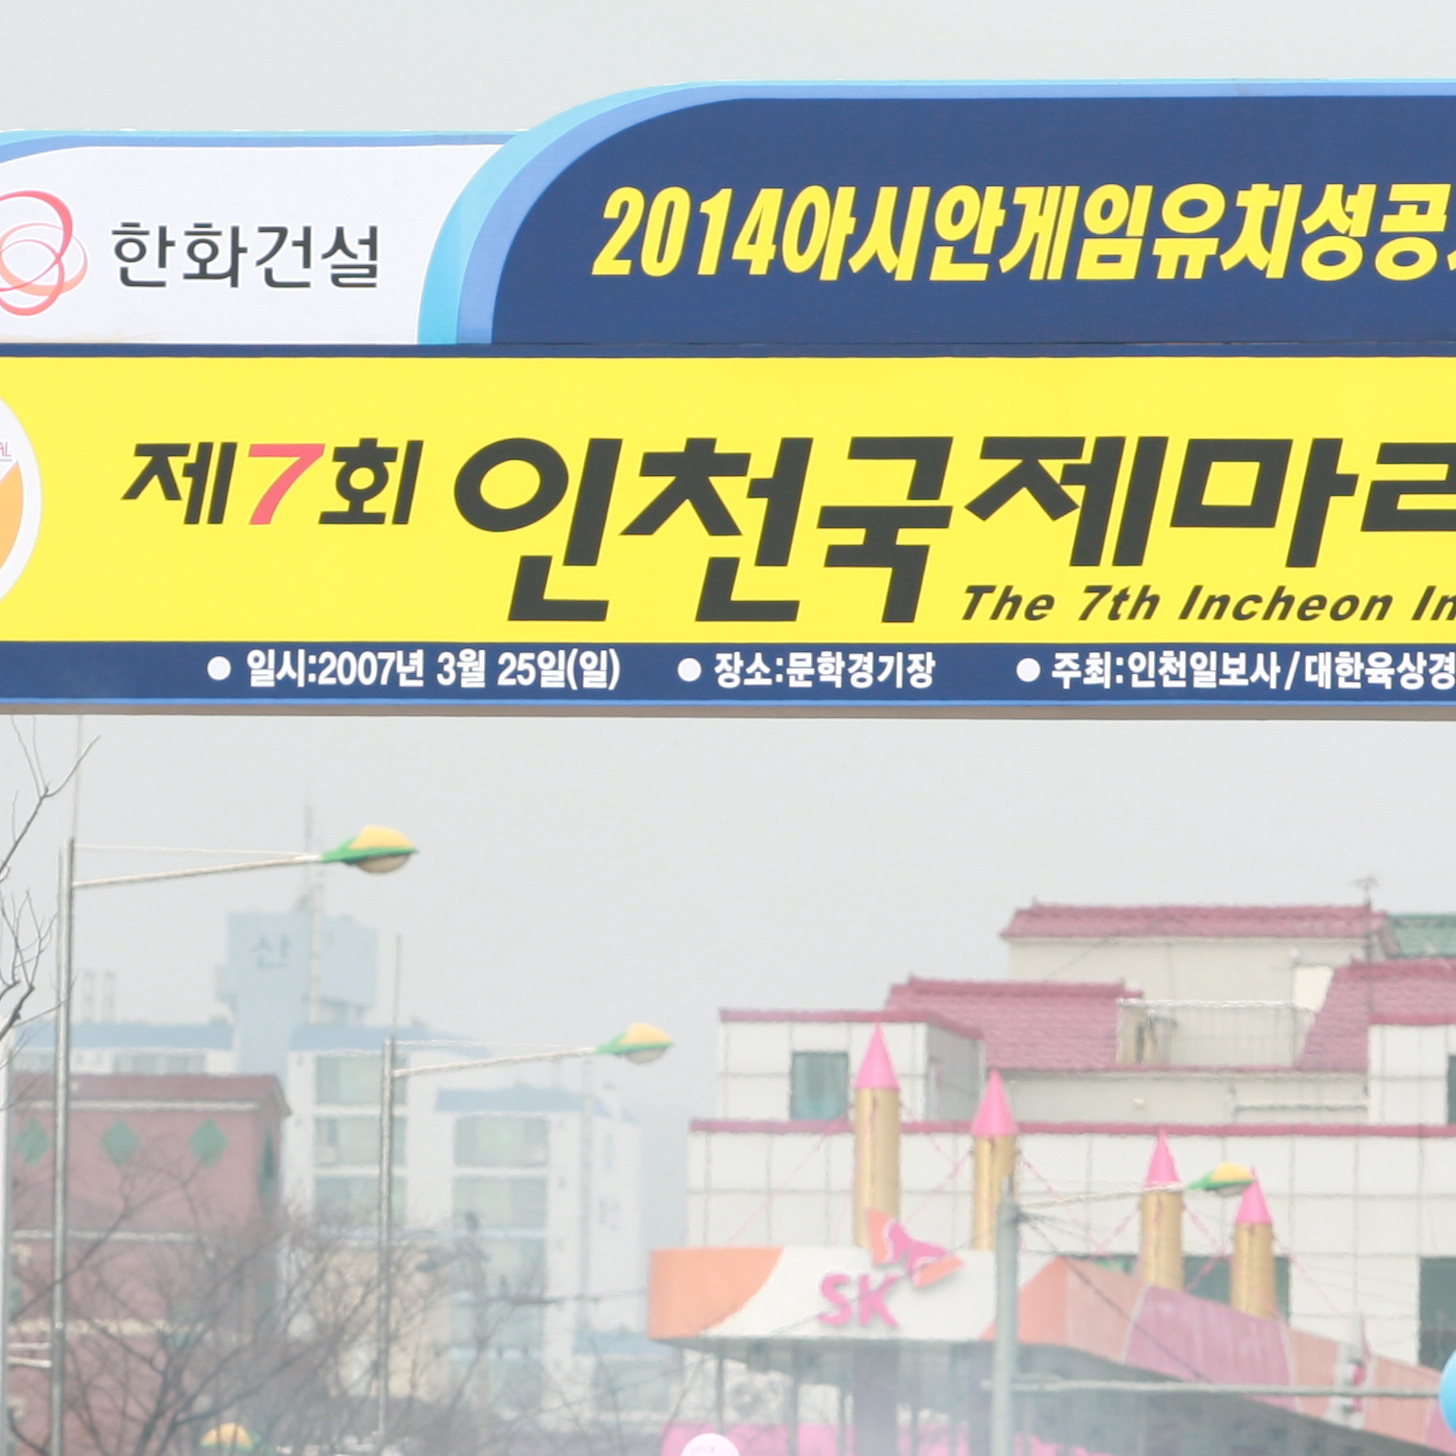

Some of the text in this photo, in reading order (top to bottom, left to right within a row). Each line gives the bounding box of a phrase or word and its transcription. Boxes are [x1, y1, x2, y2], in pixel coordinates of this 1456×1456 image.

[112, 220, 381, 289] 한화건설
[122, 436, 425, 526] 제7회
[961, 585, 1054, 622] The
[1081, 585, 1160, 621] 7th
[1182, 585, 1391, 621] Incheon
[244, 649, 621, 690] 일시:2007년 3월 25일(일)
[713, 650, 936, 688] 장소:문학경기장
[818, 1273, 899, 1328] SK
